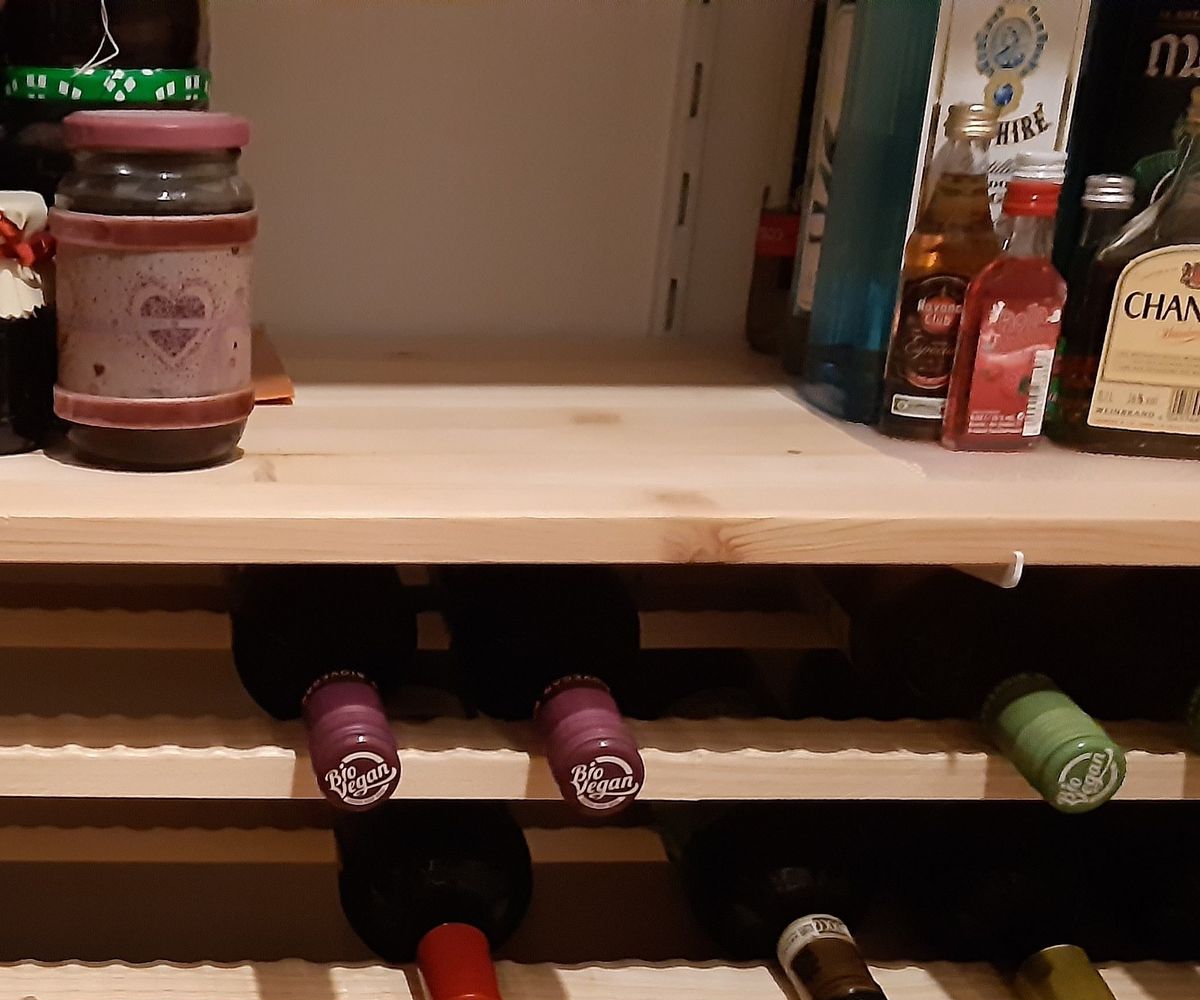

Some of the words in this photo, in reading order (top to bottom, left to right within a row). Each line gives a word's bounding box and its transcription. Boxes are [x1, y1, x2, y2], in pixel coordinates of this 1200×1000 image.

[325, 763, 356, 791] Bio
[333, 763, 397, 799] Vegan
[571, 761, 604, 783] Bio
[570, 776, 639, 800] Vegan
